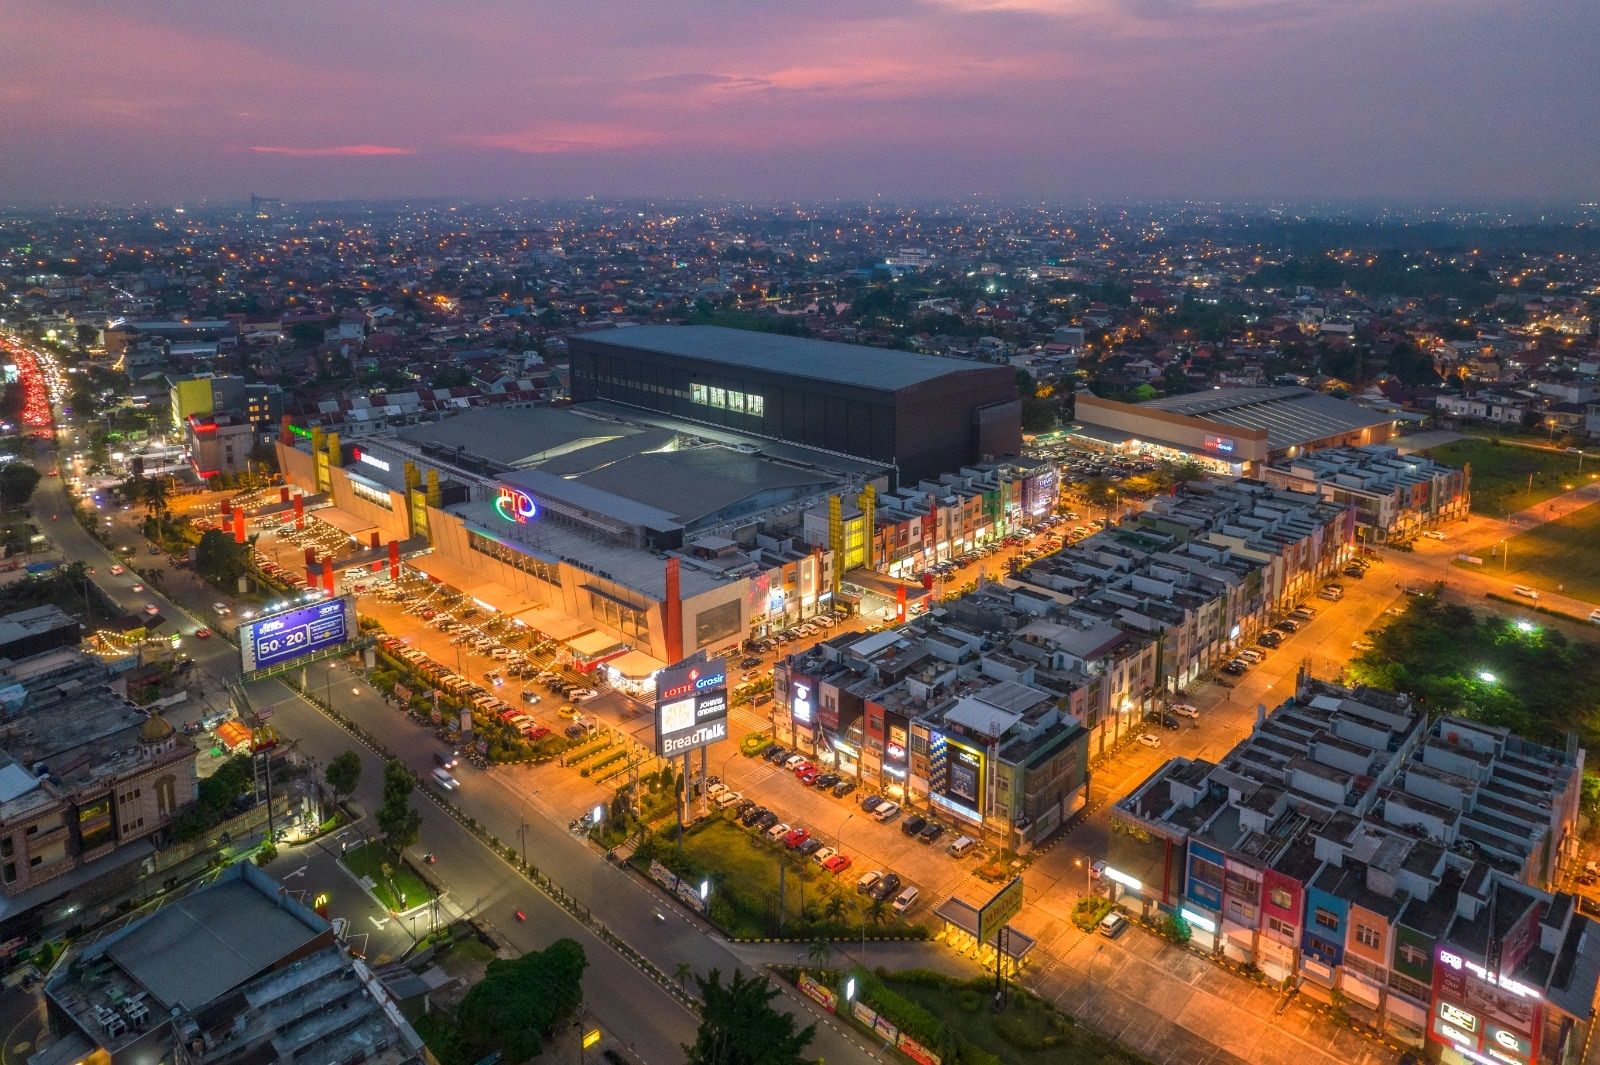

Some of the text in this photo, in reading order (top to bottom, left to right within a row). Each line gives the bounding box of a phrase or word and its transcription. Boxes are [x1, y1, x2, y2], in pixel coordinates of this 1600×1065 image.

[499, 487, 528, 514] PTC
[663, 682, 694, 698] LOTTE
[695, 674, 724, 689] Grosir
[663, 723, 726, 753] BreadTalk
[1444, 979, 1459, 989] Our
